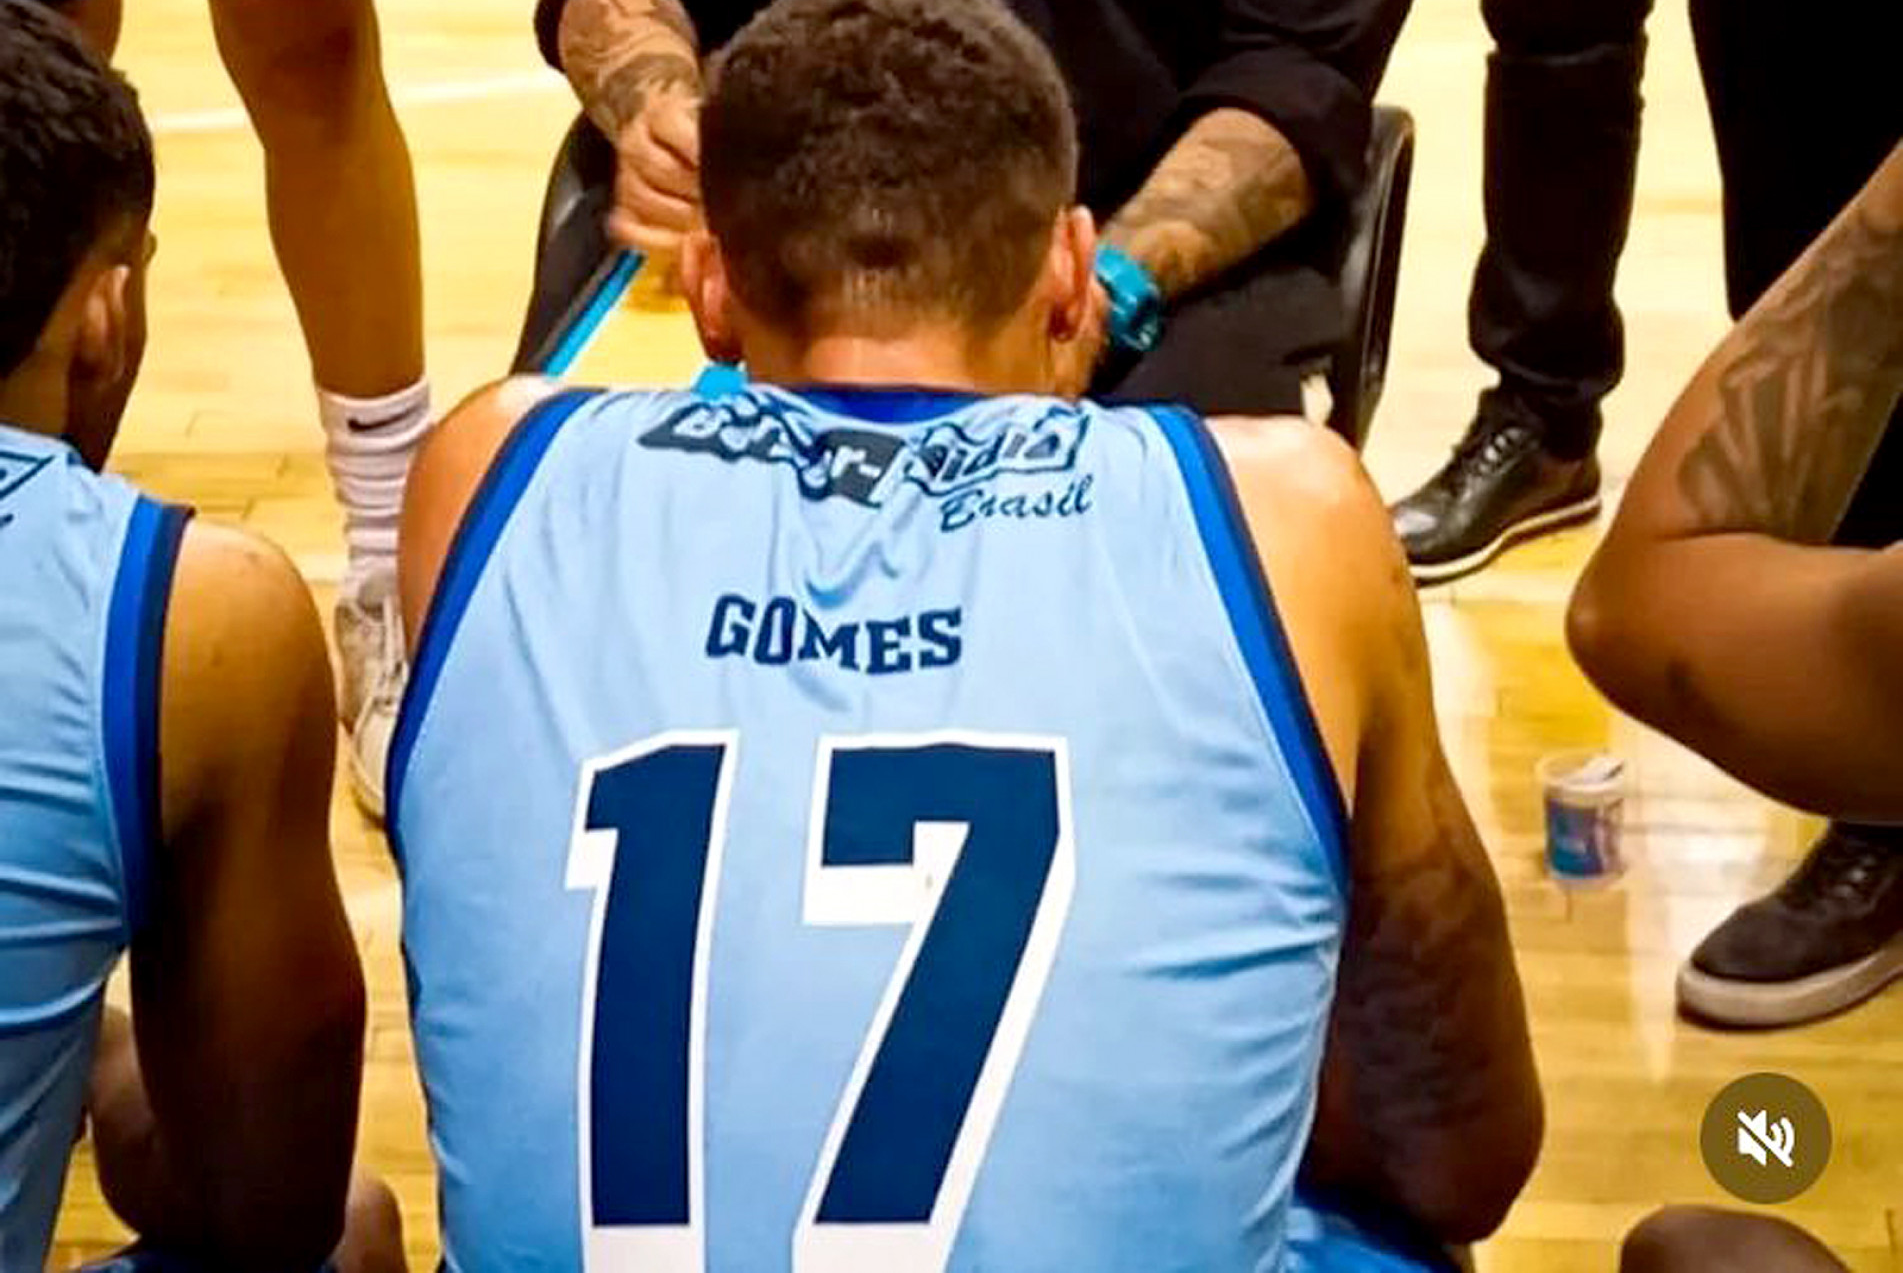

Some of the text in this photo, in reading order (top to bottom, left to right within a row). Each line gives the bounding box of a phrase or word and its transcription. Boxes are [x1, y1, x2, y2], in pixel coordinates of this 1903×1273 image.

[940, 476, 1093, 532] Brasil
[705, 594, 963, 675] GOMES
[570, 731, 1075, 1239] 17
